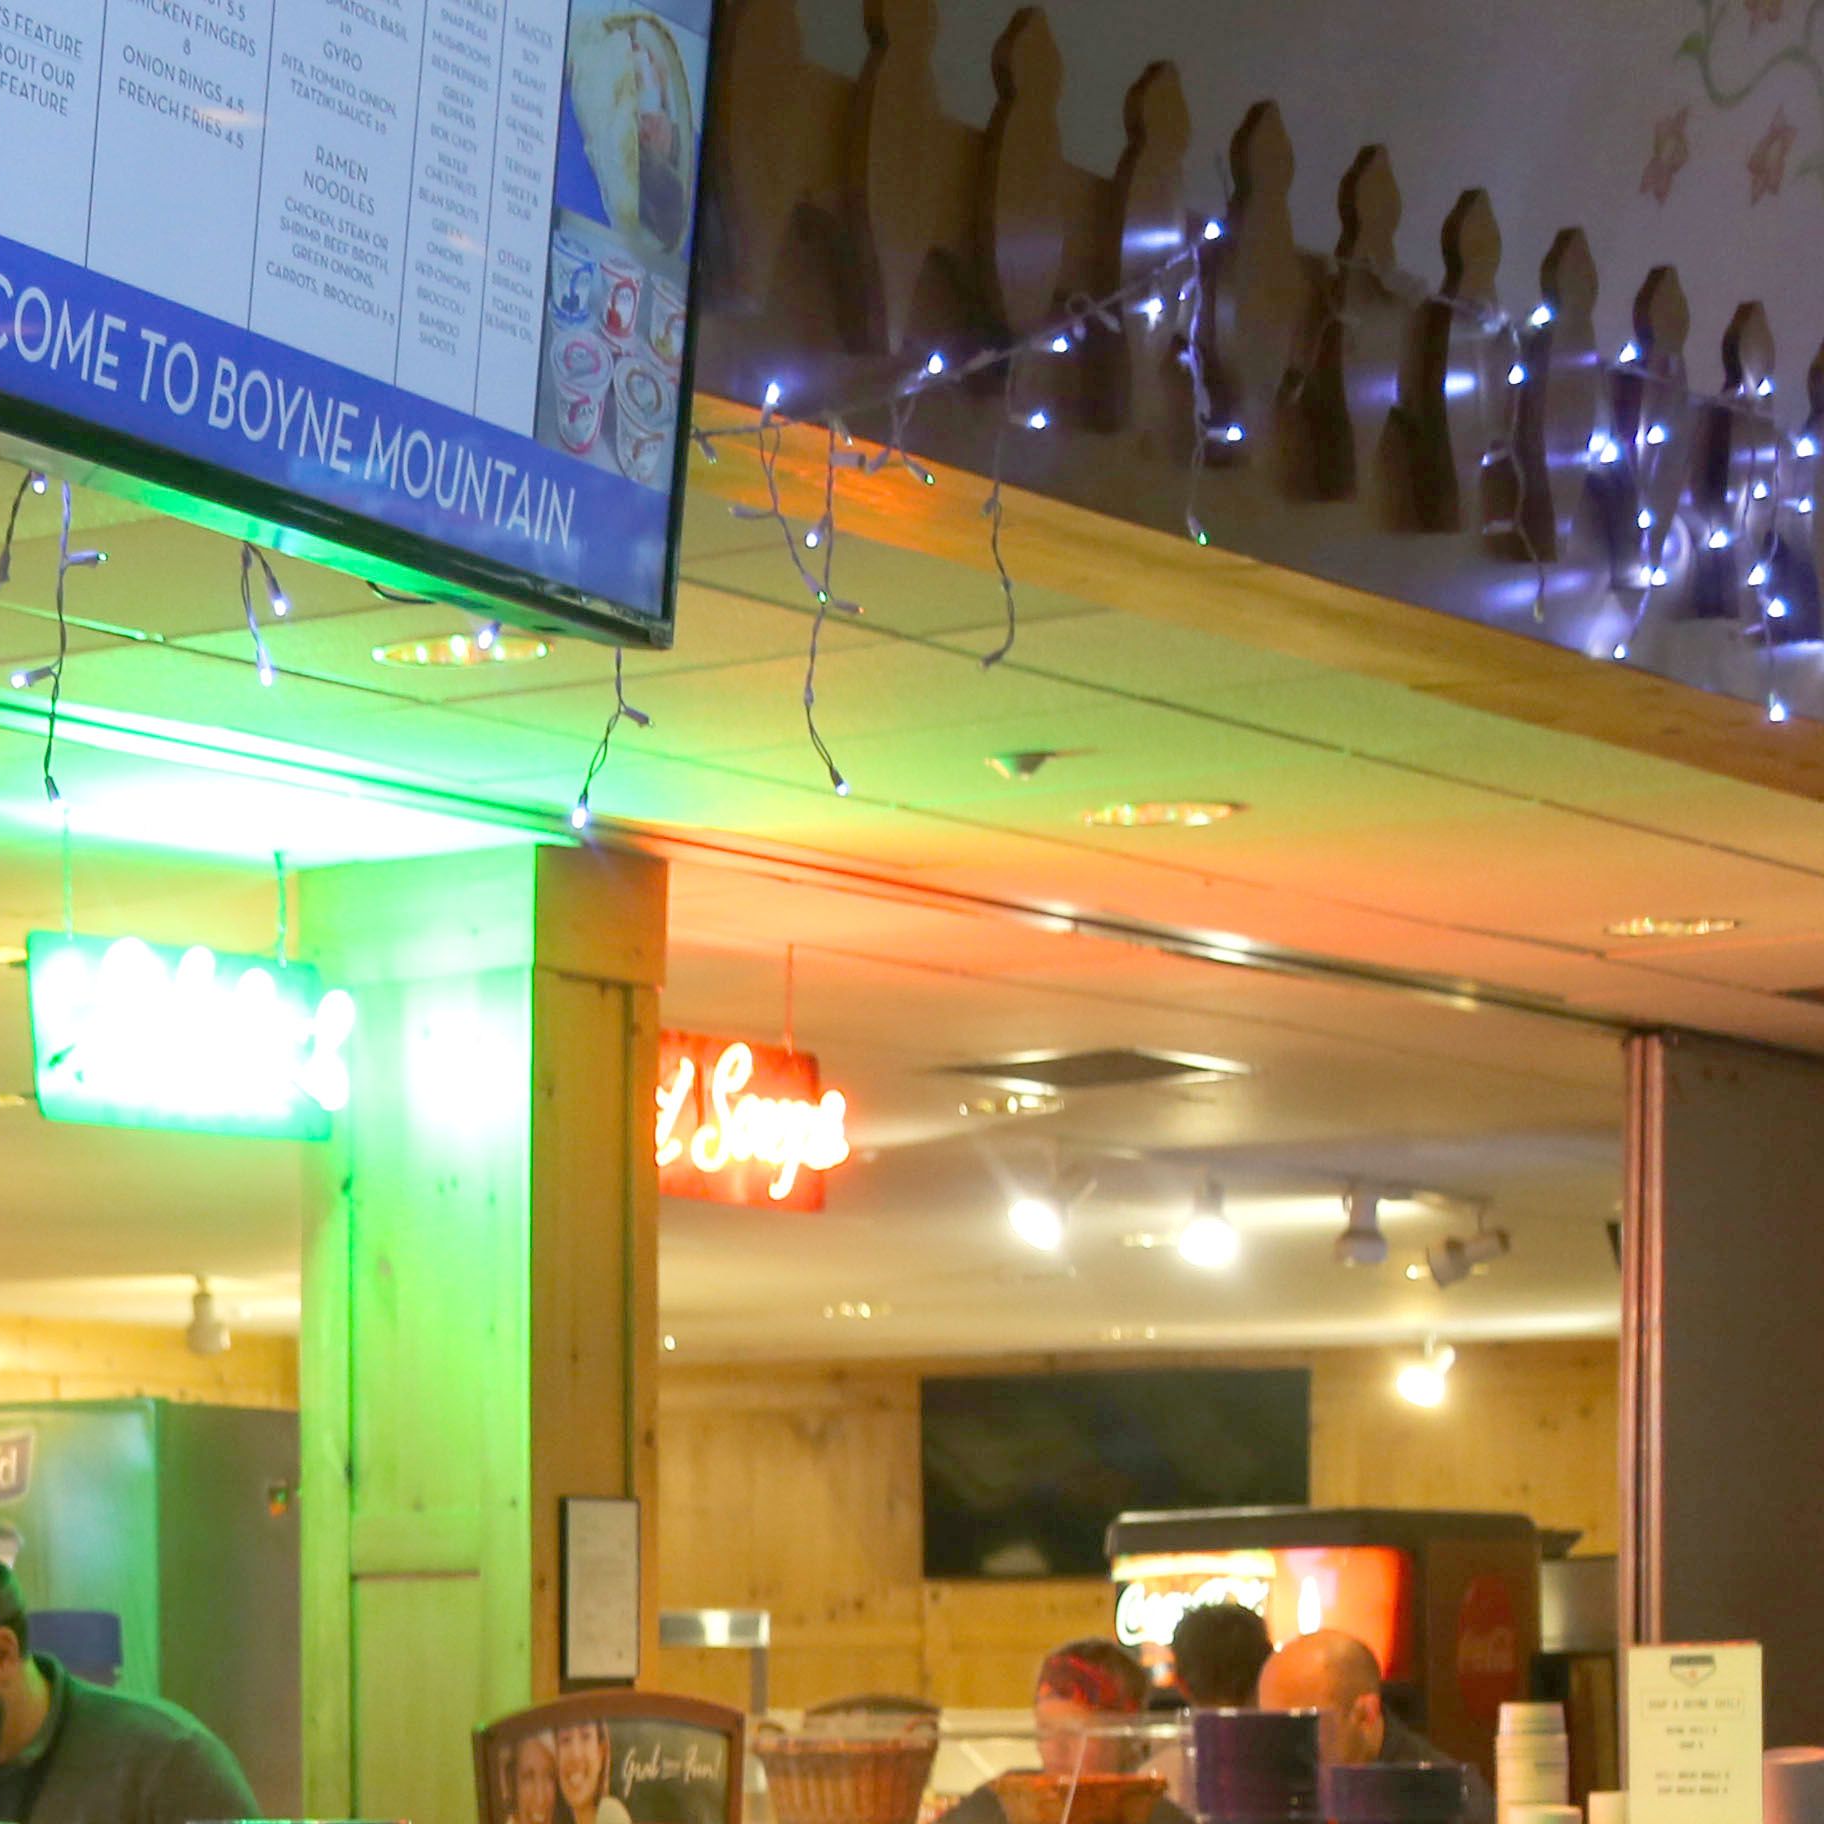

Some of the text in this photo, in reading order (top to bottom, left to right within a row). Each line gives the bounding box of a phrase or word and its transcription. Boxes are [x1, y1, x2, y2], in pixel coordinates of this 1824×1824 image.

[14, 13, 83, 58] FEATURE
[183, 39, 192, 56] 8
[195, 14, 256, 57] FINGERS
[323, 40, 363, 72] GYRO
[0, 71, 68, 117] FEATURE
[41, 61, 75, 90] OUR
[123, 43, 245, 114] ONION RINGS 4.5
[118, 76, 245, 149] FRENCH FRIES 4.5
[337, 100, 373, 128] SAUCE
[316, 144, 369, 184] RAMEN
[303, 169, 375, 216] NOODLES
[323, 234, 350, 255] BEEF
[337, 218, 370, 244] STEAK
[373, 232, 389, 252] OR
[292, 242, 329, 269] GREEN
[497, 249, 532, 274] OTHER
[323, 282, 380, 319] BROCCOLI
[139, 332, 200, 413] TO
[211, 356, 357, 473] BOYNE
[363, 416, 576, 549] MOUNTAIN
